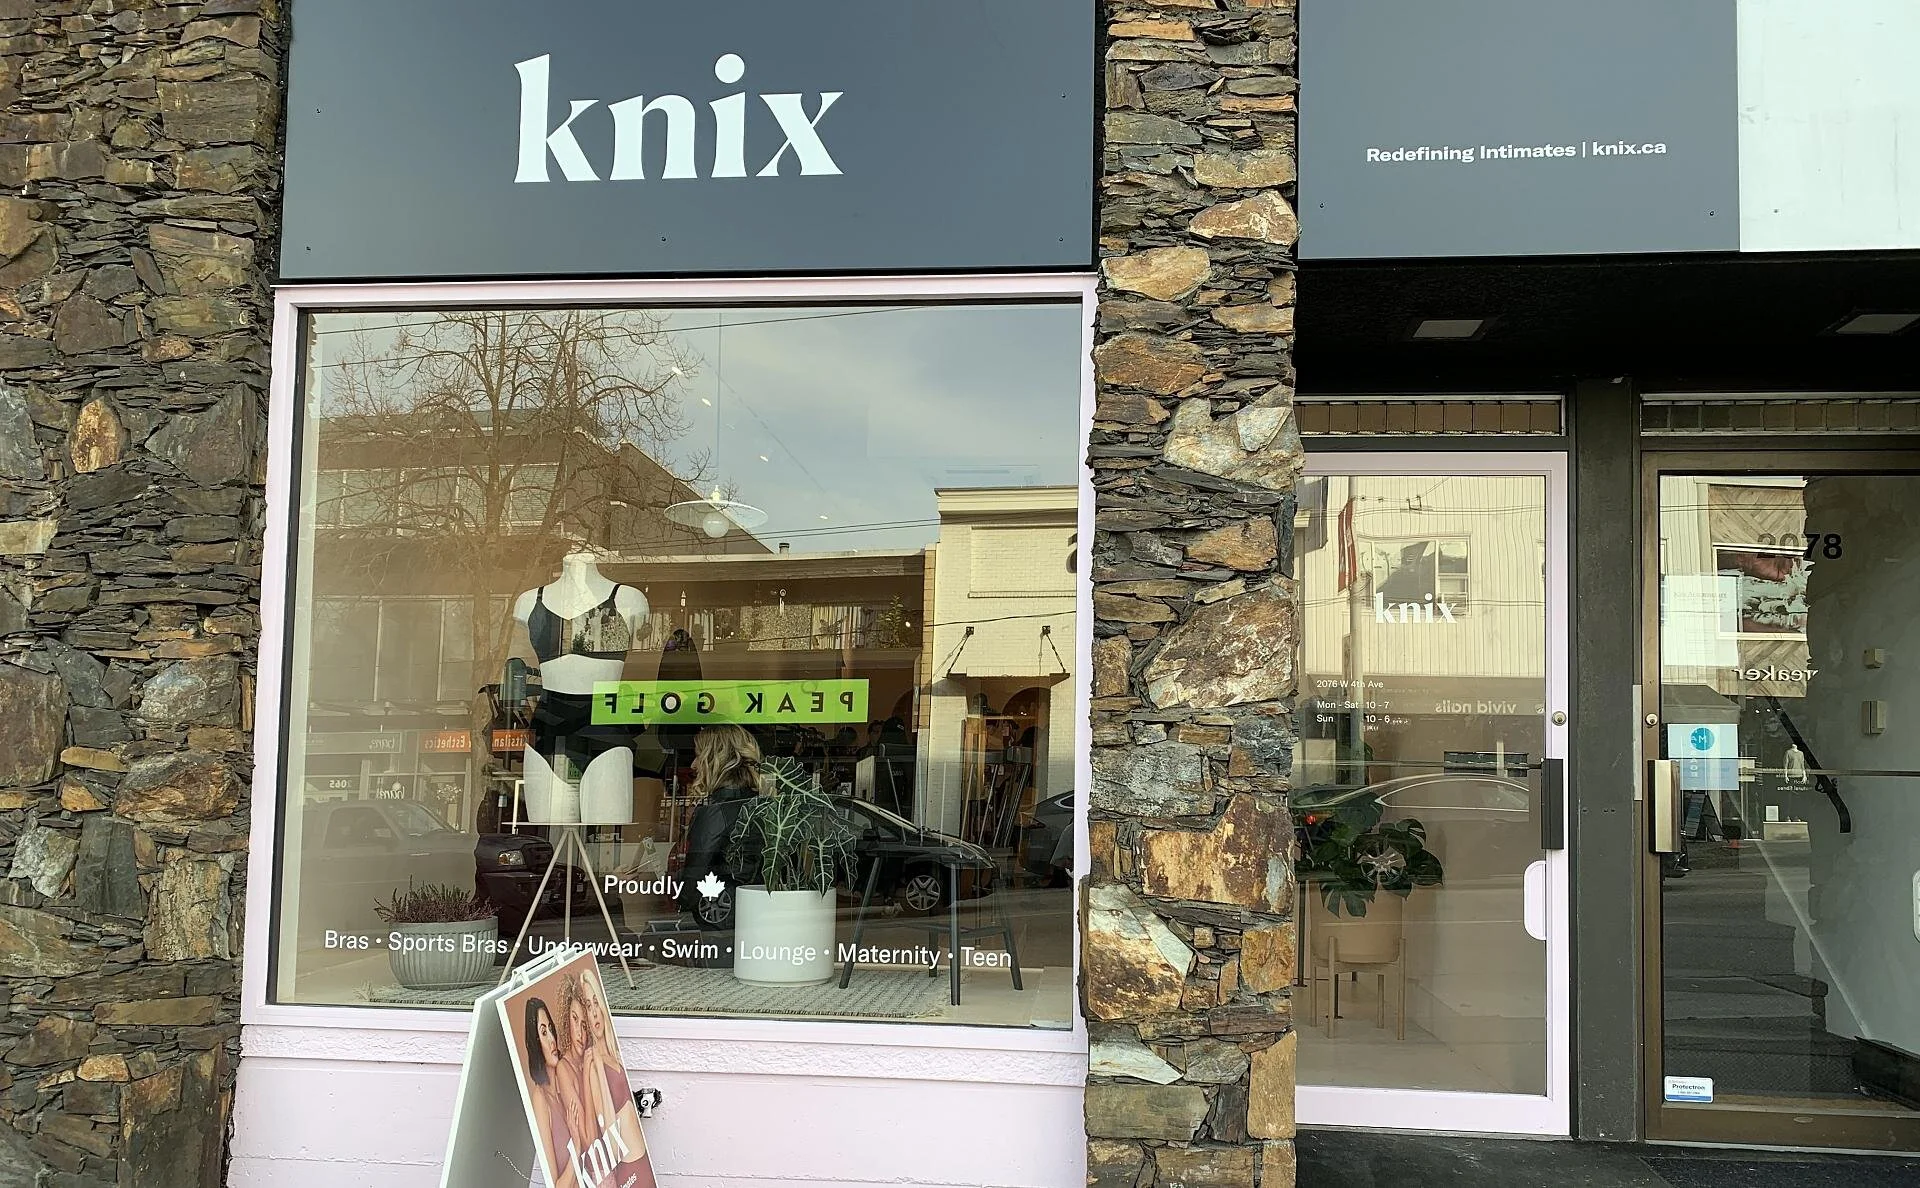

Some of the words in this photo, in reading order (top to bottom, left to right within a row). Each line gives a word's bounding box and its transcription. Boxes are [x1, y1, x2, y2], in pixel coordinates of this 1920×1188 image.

[514, 53, 844, 183] knix
[1366, 146, 1475, 164] Redefining
[1480, 144, 1577, 160] Intimates
[1592, 141, 1667, 156] knix.ca
[1375, 592, 1458, 624] knix
[1316, 680, 1338, 689] 2076
[1339, 680, 1349, 689] W
[1367, 680, 1384, 689] Ave
[1316, 701, 1336, 709] Mon
[1344, 701, 1359, 709] Sat
[1365, 701, 1377, 709] 10
[1383, 701, 1390, 709] 7
[1316, 714, 1334, 722] Sun
[1365, 714, 1377, 722] 10
[1384, 714, 1391, 723] 6
[604, 875, 684, 899] Proudly
[324, 930, 369, 950] Bras
[388, 932, 455, 955] Sports
[463, 934, 507, 954] Bras
[661, 939, 718, 959] Swim
[740, 941, 816, 965] Lounge
[838, 943, 941, 969] Maternity
[961, 946, 1012, 968] Teen
[567, 1113, 630, 1188] knix
